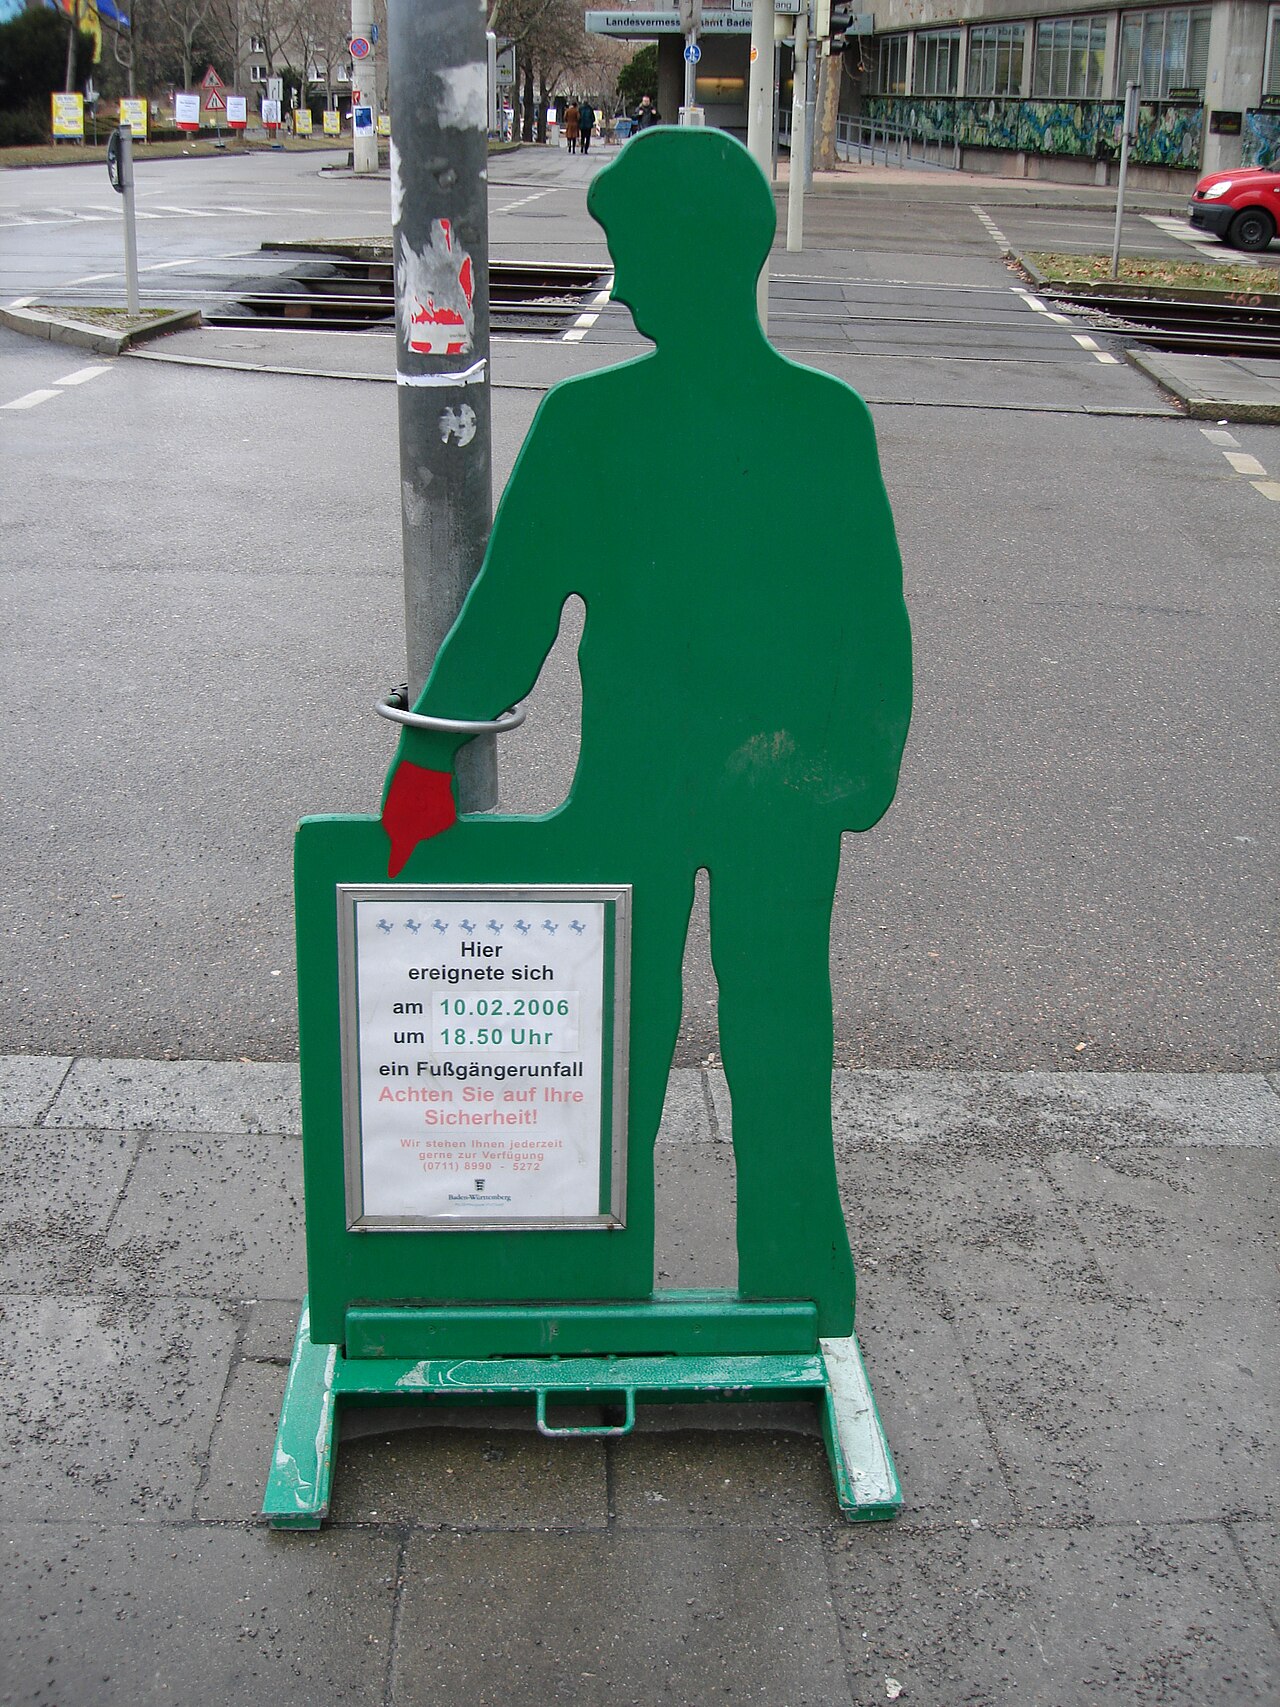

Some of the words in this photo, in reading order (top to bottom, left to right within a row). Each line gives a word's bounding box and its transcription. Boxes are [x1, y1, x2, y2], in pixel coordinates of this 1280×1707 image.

[461, 941, 503, 958] Hier
[408, 964, 505, 985] ereignete
[511, 964, 554, 981] sich
[392, 1002, 423, 1015] am
[440, 998, 569, 1016] 10.02.2006
[393, 1031, 425, 1044] um
[440, 1028, 503, 1046] 18.50
[511, 1028, 553, 1046] Uhr
[378, 1061, 409, 1076] ein
[416, 1061, 583, 1081] Fußgängerunfall
[378, 1086, 453, 1104] Achten
[462, 1086, 495, 1103] Sie
[503, 1086, 537, 1102] auf
[544, 1086, 584, 1103] Ihre
[423, 1108, 538, 1126] Sicherheit!
[400, 1138, 421, 1148] Wir
[425, 1139, 466, 1148] stehen
[471, 1139, 505, 1149] Ihnen
[509, 1139, 563, 1151] jederzeit
[418, 1152, 453, 1161] gerne
[481, 1150, 544, 1162] Verfügung
[422, 1161, 459, 1172] (0711)
[464, 1161, 492, 1171] 8990
[512, 1162, 541, 1171] 5272
